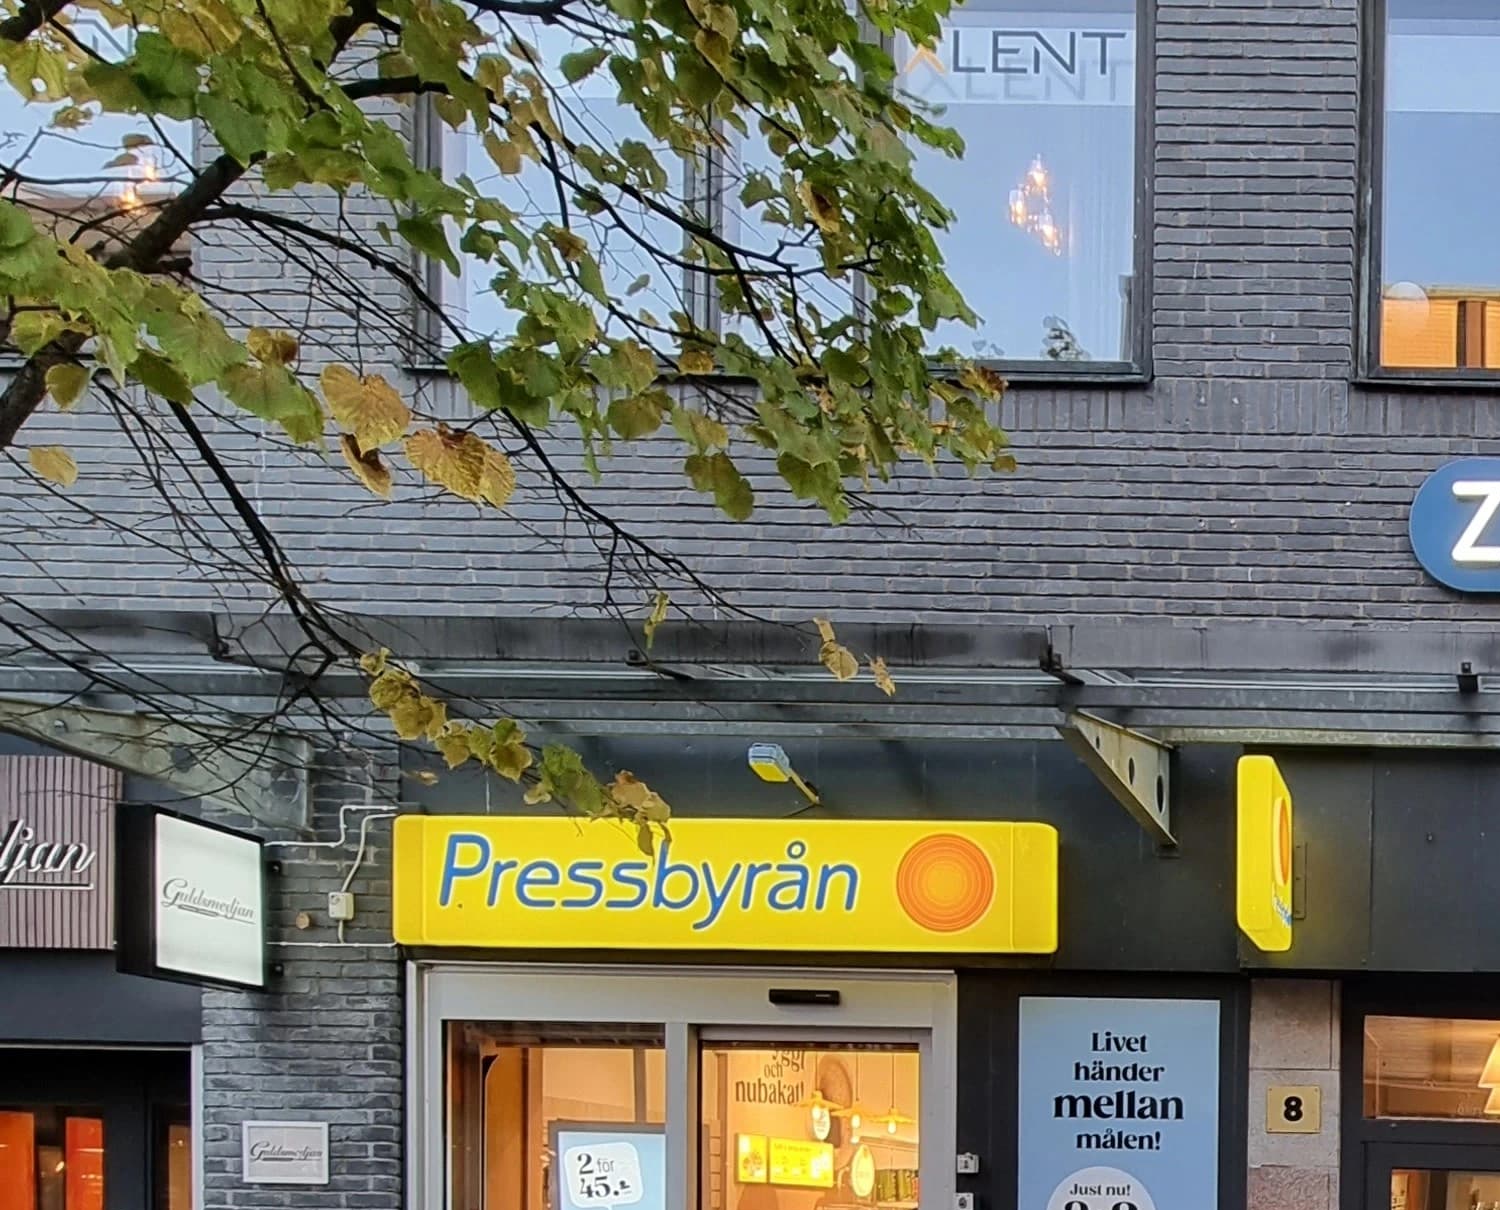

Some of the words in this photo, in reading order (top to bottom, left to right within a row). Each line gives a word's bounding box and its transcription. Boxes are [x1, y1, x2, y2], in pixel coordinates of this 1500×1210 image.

[438, 832, 859, 930] Pressbyrån
[161, 877, 256, 924] Guldsmedjan
[1091, 1031, 1148, 1052] Livet
[764, 1062, 783, 1079] och
[1074, 1060, 1165, 1082] händer
[1053, 1090, 1184, 1120] mellan
[1284, 1095, 1303, 1122] 8
[1076, 1128, 1161, 1151] målen!
[577, 1153, 594, 1175] 2
[1069, 1183, 1102, 1196] Just
[1106, 1184, 1131, 1197] nu!
